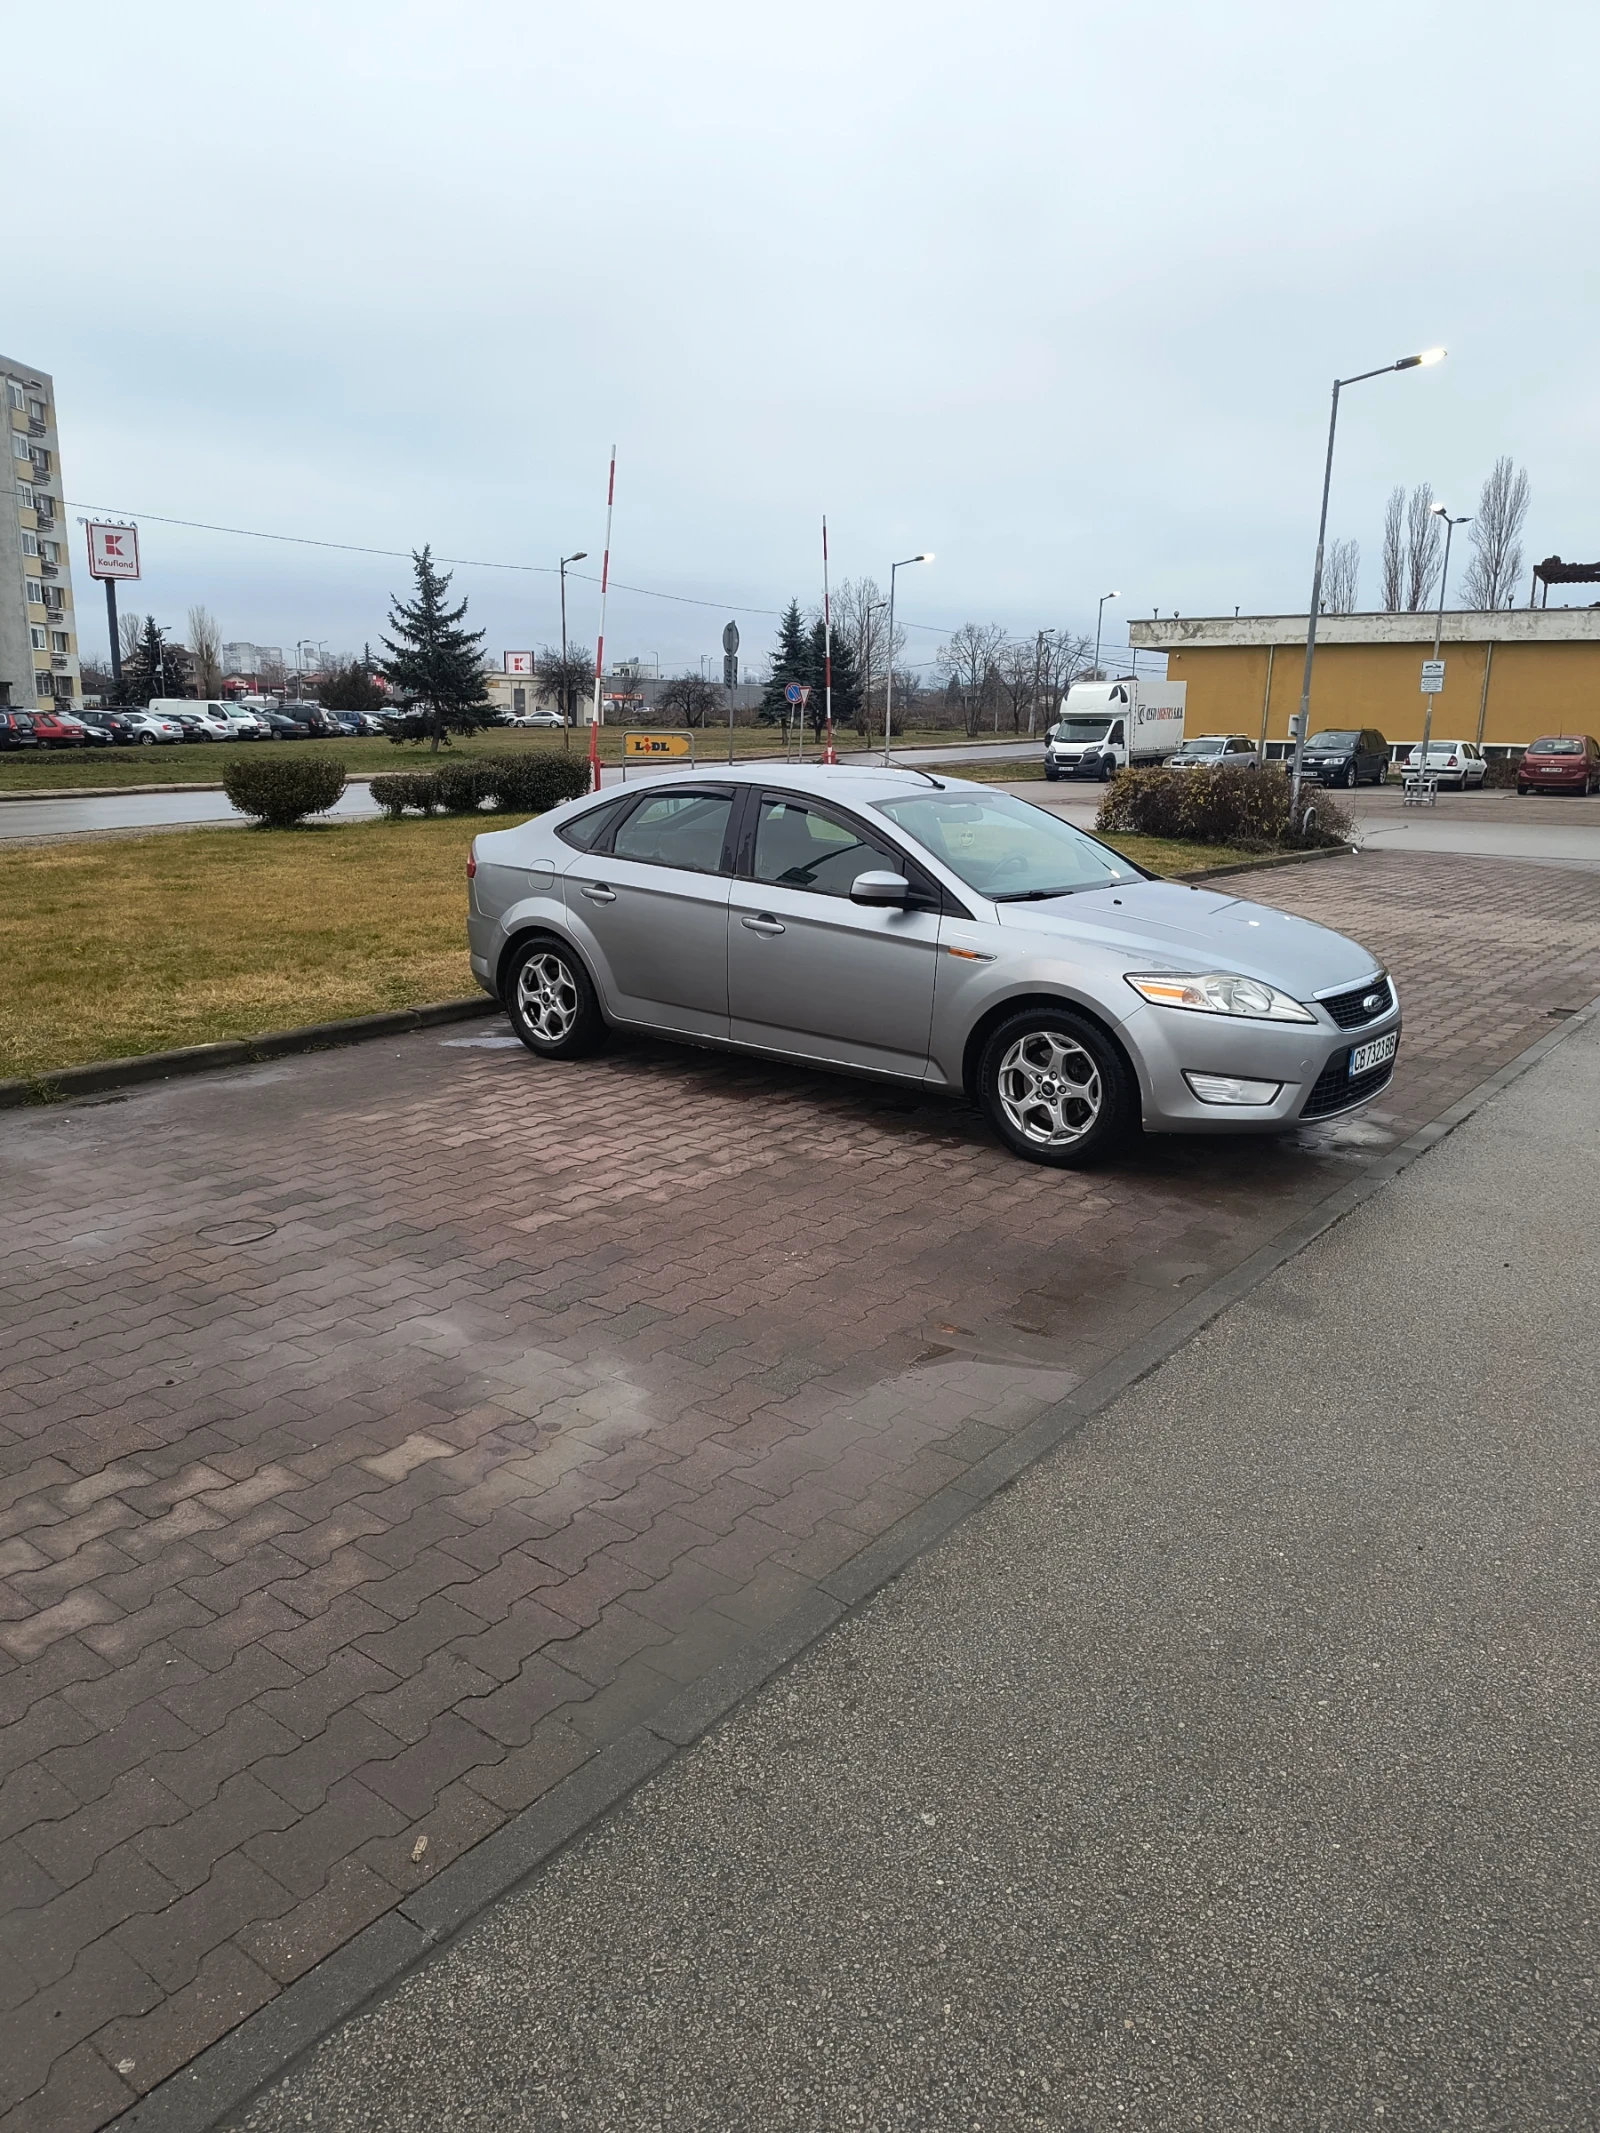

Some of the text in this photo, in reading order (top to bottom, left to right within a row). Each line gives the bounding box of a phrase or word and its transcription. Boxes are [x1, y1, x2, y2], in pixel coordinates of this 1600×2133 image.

[98, 558, 133, 568] Kaufland
[1355, 1050, 1366, 1071] CB
[1367, 1041, 1385, 1066] 7323
